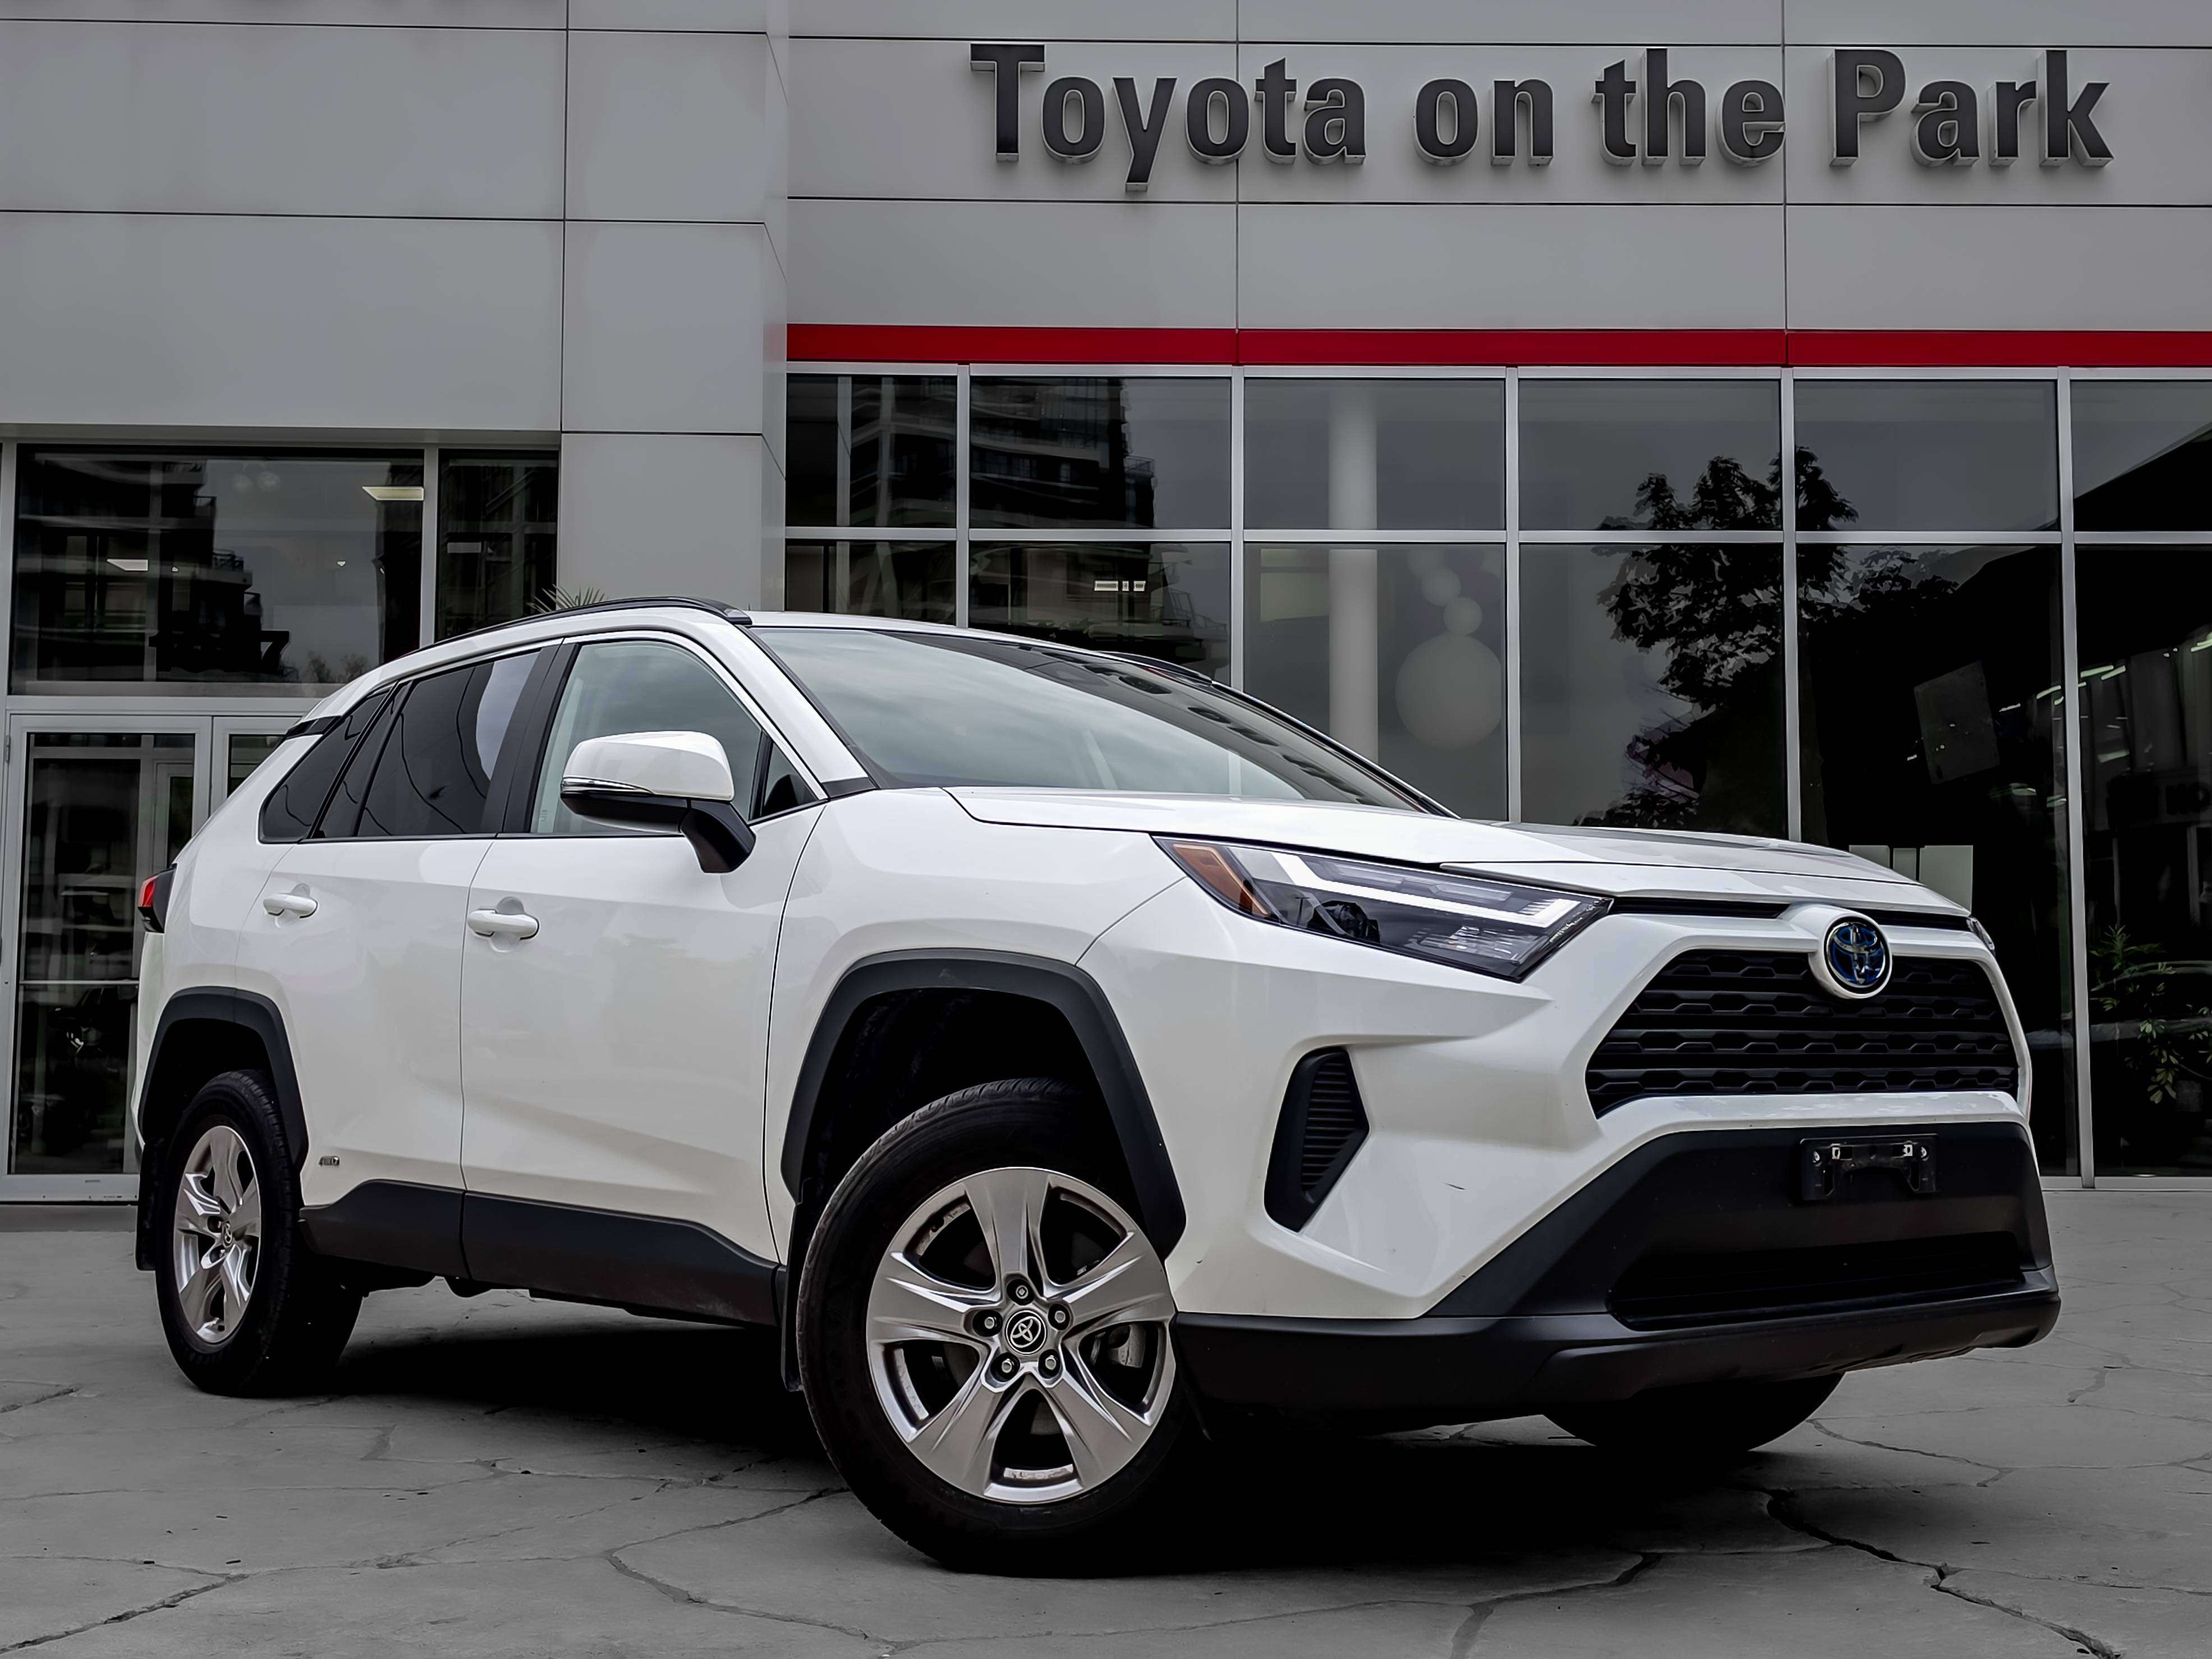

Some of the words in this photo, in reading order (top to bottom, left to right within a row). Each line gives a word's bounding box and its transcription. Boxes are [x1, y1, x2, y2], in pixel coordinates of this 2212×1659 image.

[970, 43, 1366, 190] Toyota
[1414, 77, 1554, 165] on
[1593, 48, 1786, 165] the
[1828, 49, 2114, 167] Park
